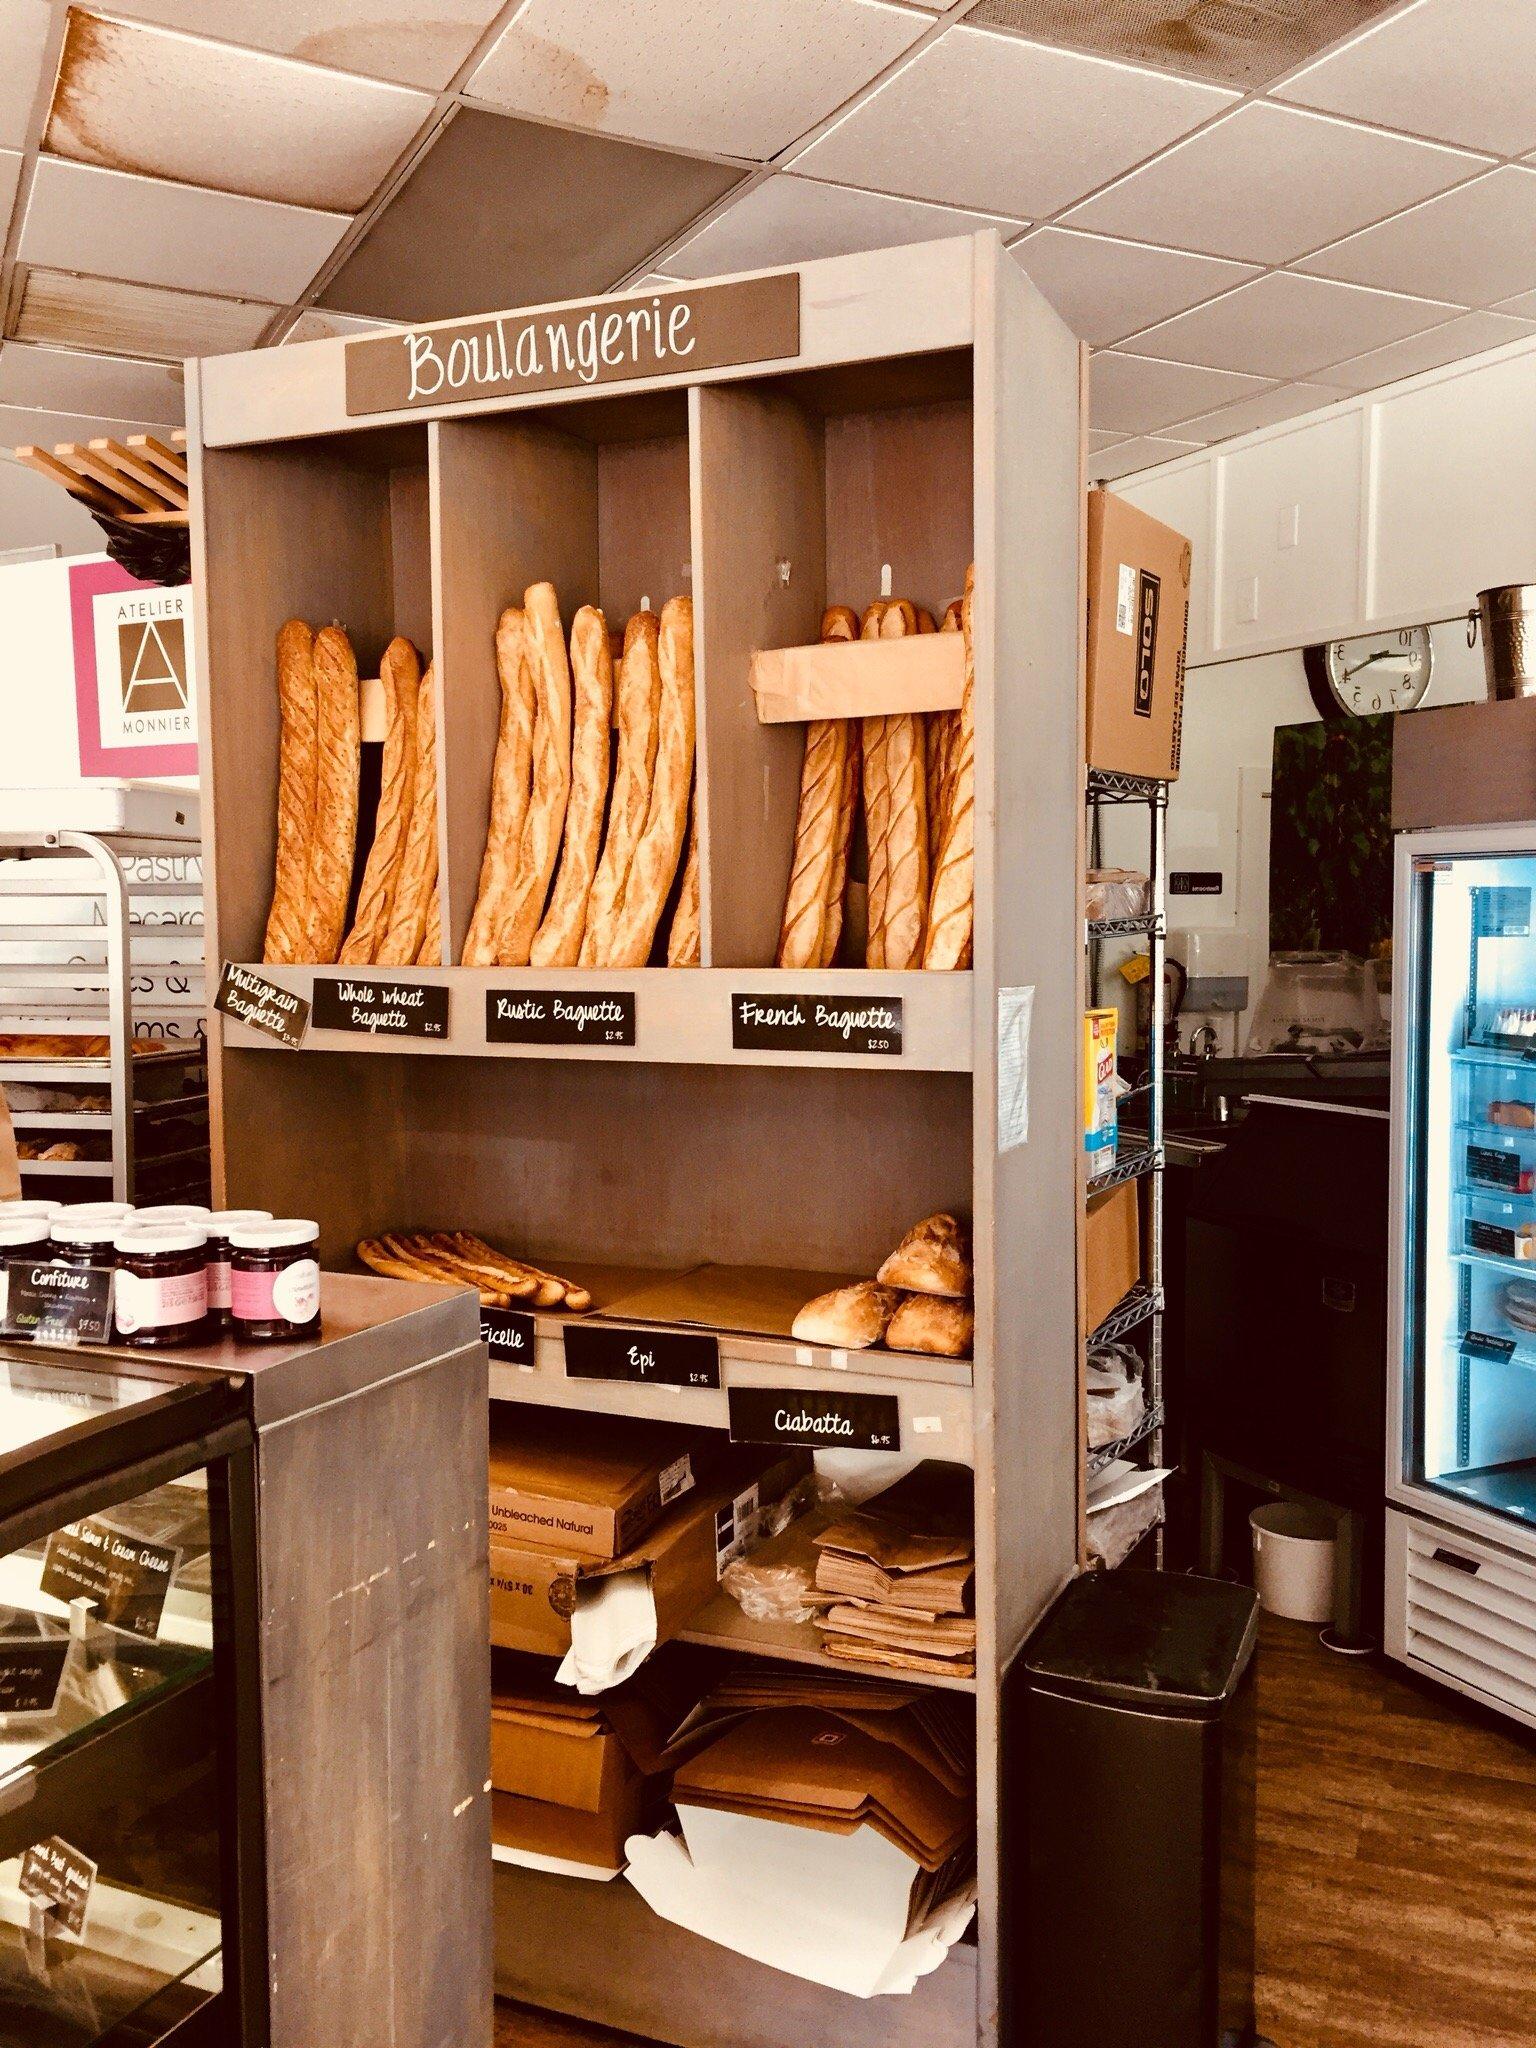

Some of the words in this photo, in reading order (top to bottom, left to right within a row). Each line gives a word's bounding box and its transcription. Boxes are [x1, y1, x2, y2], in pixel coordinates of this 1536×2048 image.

[403, 298, 696, 400] Boulangerie
[118, 599, 183, 619] ATELIER
[1140, 588, 1153, 700] SOLO
[123, 717, 190, 734] MONNIER
[227, 964, 298, 1013] Multigrain
[337, 982, 375, 1003] Whole
[382, 986, 424, 1006] wheat
[226, 989, 285, 1032] Baguette
[352, 1006, 408, 1033] Baguette
[497, 998, 546, 1019] Rustic
[552, 999, 624, 1031] Baguette
[738, 1001, 806, 1026] French
[815, 1004, 895, 1039] Baguette
[31, 1268, 89, 1289] Confiture
[627, 1345, 655, 1374] Epi
[774, 1409, 854, 1435] Ciabatta
[491, 1505, 554, 1527] Unbleached
[556, 1518, 594, 1535] Natural
